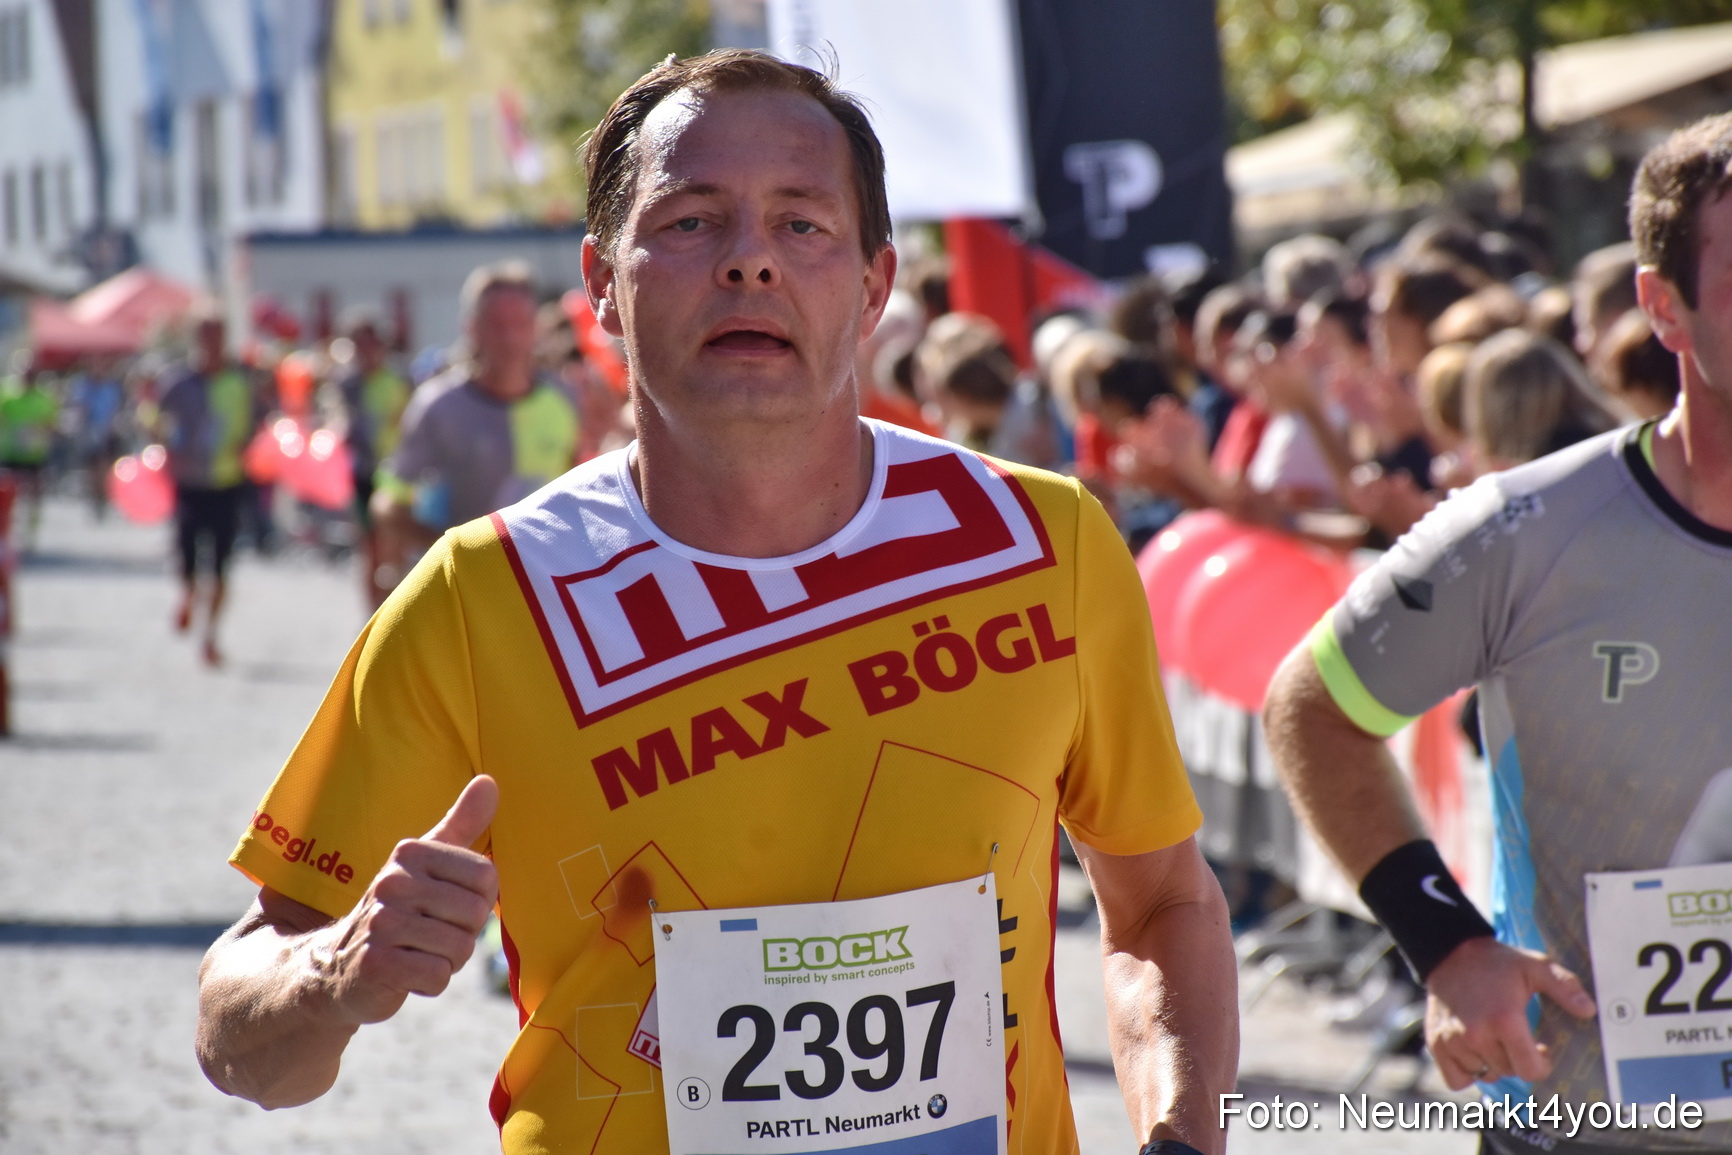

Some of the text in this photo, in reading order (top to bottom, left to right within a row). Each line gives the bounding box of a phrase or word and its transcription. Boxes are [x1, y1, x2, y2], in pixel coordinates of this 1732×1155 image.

[590, 602, 1077, 812] MAX BÖGL
[762, 925, 914, 973] BOCK
[764, 961, 916, 987] inspired by smart concepts
[716, 980, 956, 1102] 2397
[1665, 1026, 1724, 1044] PARTL
[687, 1085, 700, 1102] B
[746, 1118, 820, 1139] PARTL
[825, 1104, 921, 1135] Neumarkt
